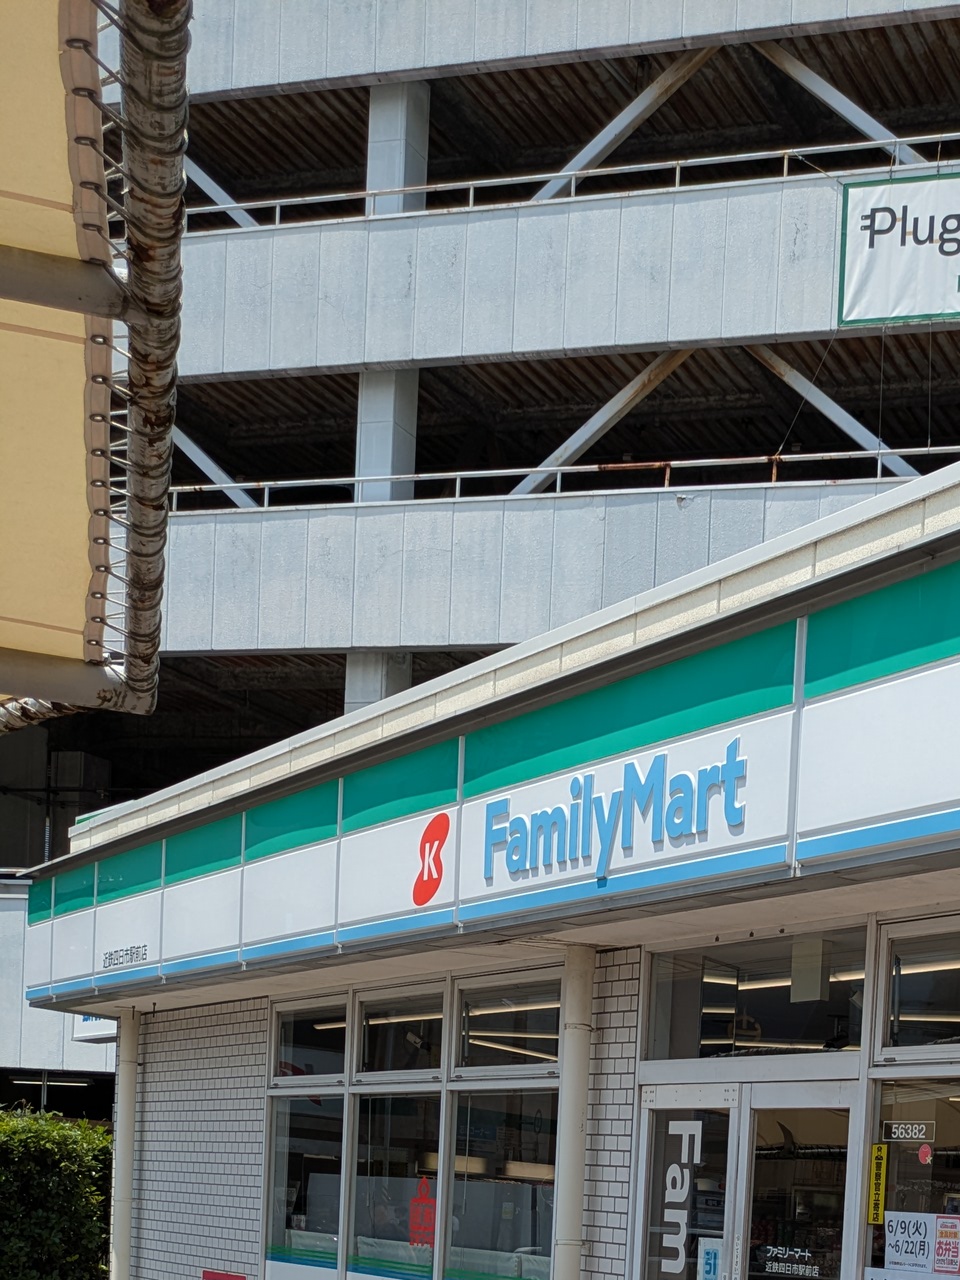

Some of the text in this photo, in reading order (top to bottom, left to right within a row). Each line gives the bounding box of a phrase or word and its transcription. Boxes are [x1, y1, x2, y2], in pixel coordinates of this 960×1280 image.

[483, 735, 747, 888] FamilyMart
[103, 945, 148, 969] 近鉄四日市駅前店
[891, 1124, 926, 1139] 56382
[887, 1219, 928, 1237] 6/9(火)
[766, 1246, 812, 1261] ファミリーマート
[936, 1240, 959, 1258] お弁当
[765, 1261, 820, 1277] 近鉄四日市駅前店
